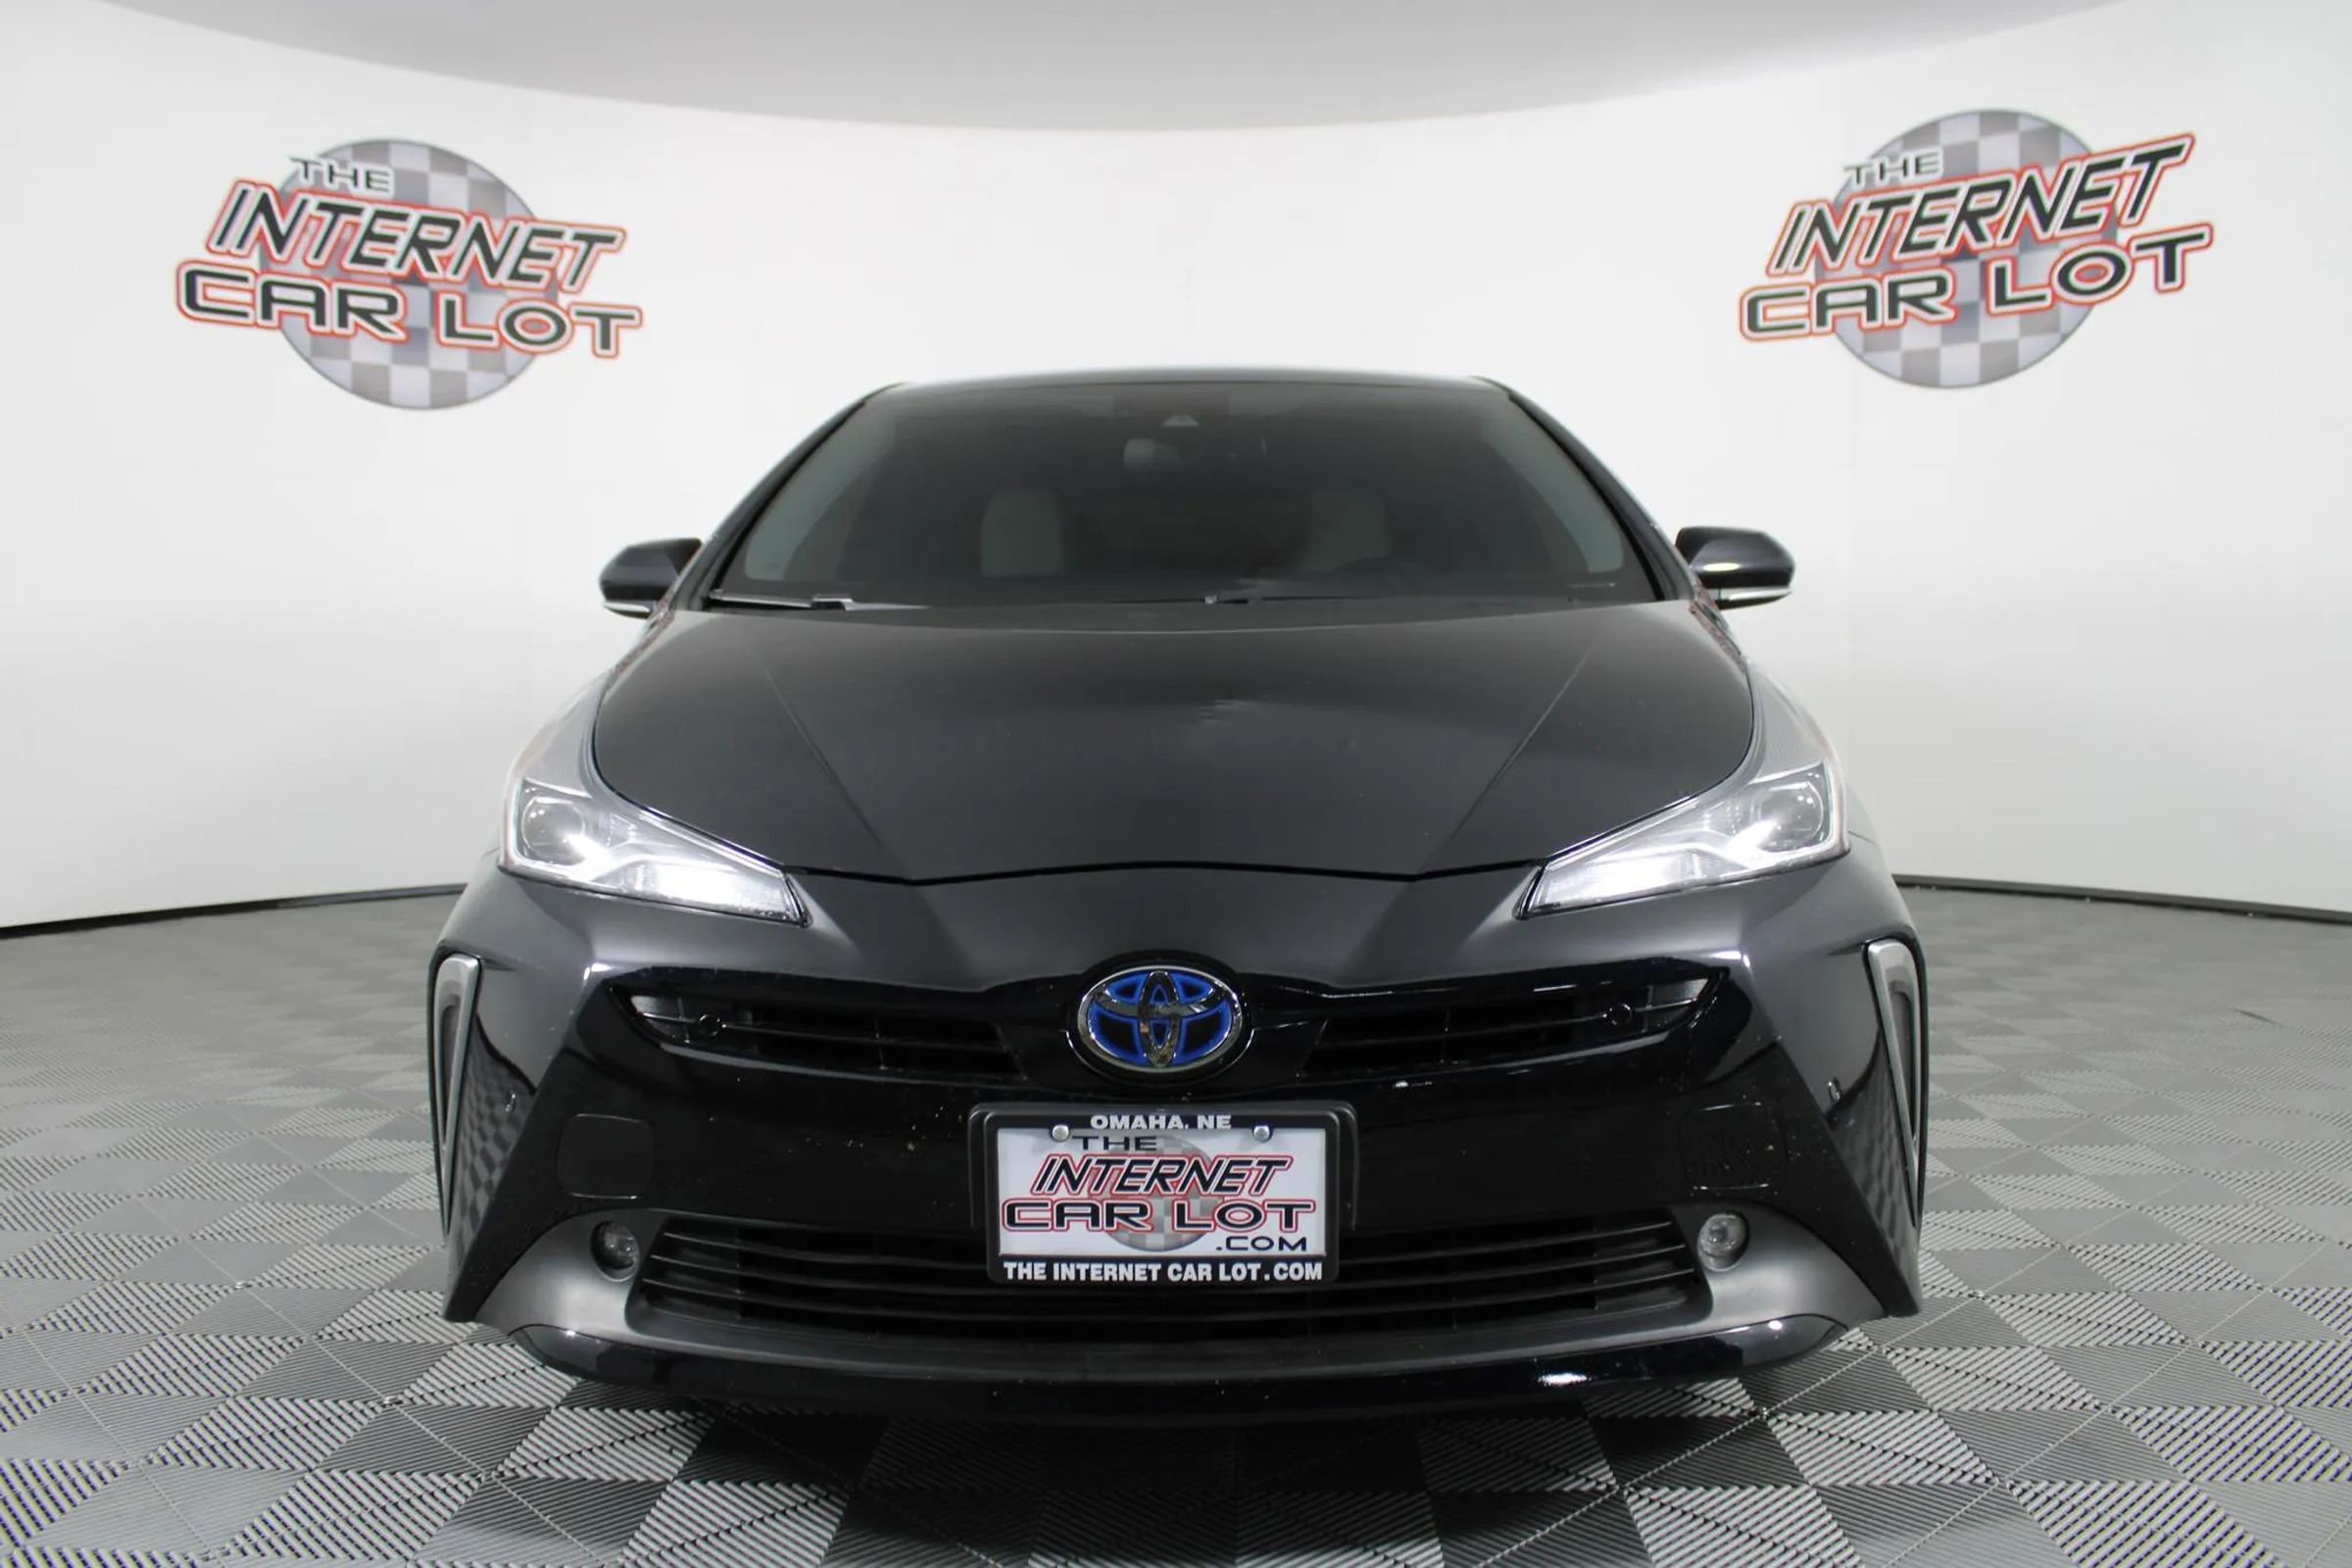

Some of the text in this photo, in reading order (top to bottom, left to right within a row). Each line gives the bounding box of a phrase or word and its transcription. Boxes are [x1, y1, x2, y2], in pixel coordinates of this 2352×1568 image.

[291, 158, 391, 192] THE
[1843, 154, 1943, 185] THE
[1774, 142, 2187, 270] INTERNET
[215, 187, 619, 287] INTERNET
[1745, 230, 2208, 334] CAR LOT
[183, 268, 637, 352] CAR LOT
[1197, 1114, 1232, 1130] NE
[1072, 1135, 1157, 1152] THE
[1034, 1156, 1289, 1194] INTERNET
[1005, 1201, 1313, 1229] CAR LOT
[1216, 1236, 1307, 1251] .COM
[1004, 1262, 1047, 1281] THE
[1054, 1262, 1161, 1281] INTERNET
[1167, 1262, 1213, 1281] CAR
